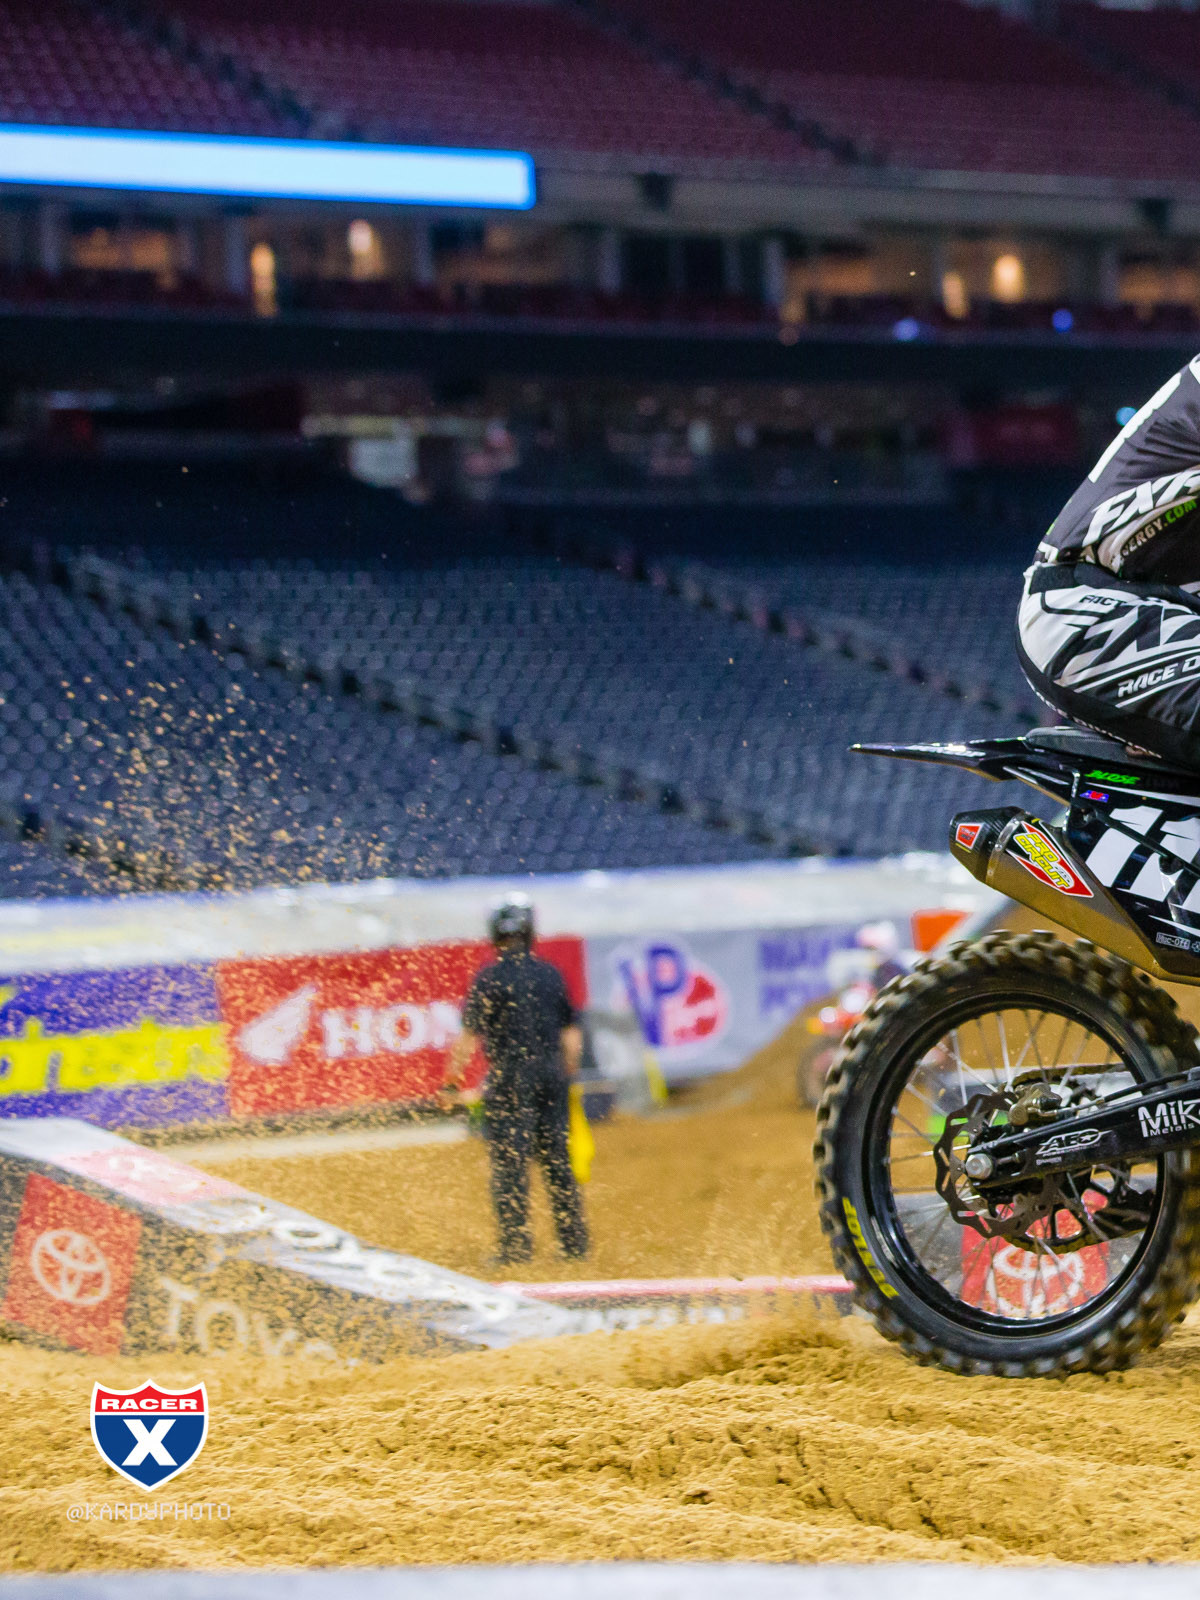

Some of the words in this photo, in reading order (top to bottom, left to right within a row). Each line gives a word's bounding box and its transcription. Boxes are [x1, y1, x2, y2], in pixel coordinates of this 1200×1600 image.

[1117, 663, 1180, 698] RACE
[1014, 834, 1071, 889] CIRCUIT
[1026, 832, 1060, 863] PRO
[618, 942, 687, 1047] VP
[320, 1002, 464, 1060] HON
[1150, 1121, 1195, 1138] Metals
